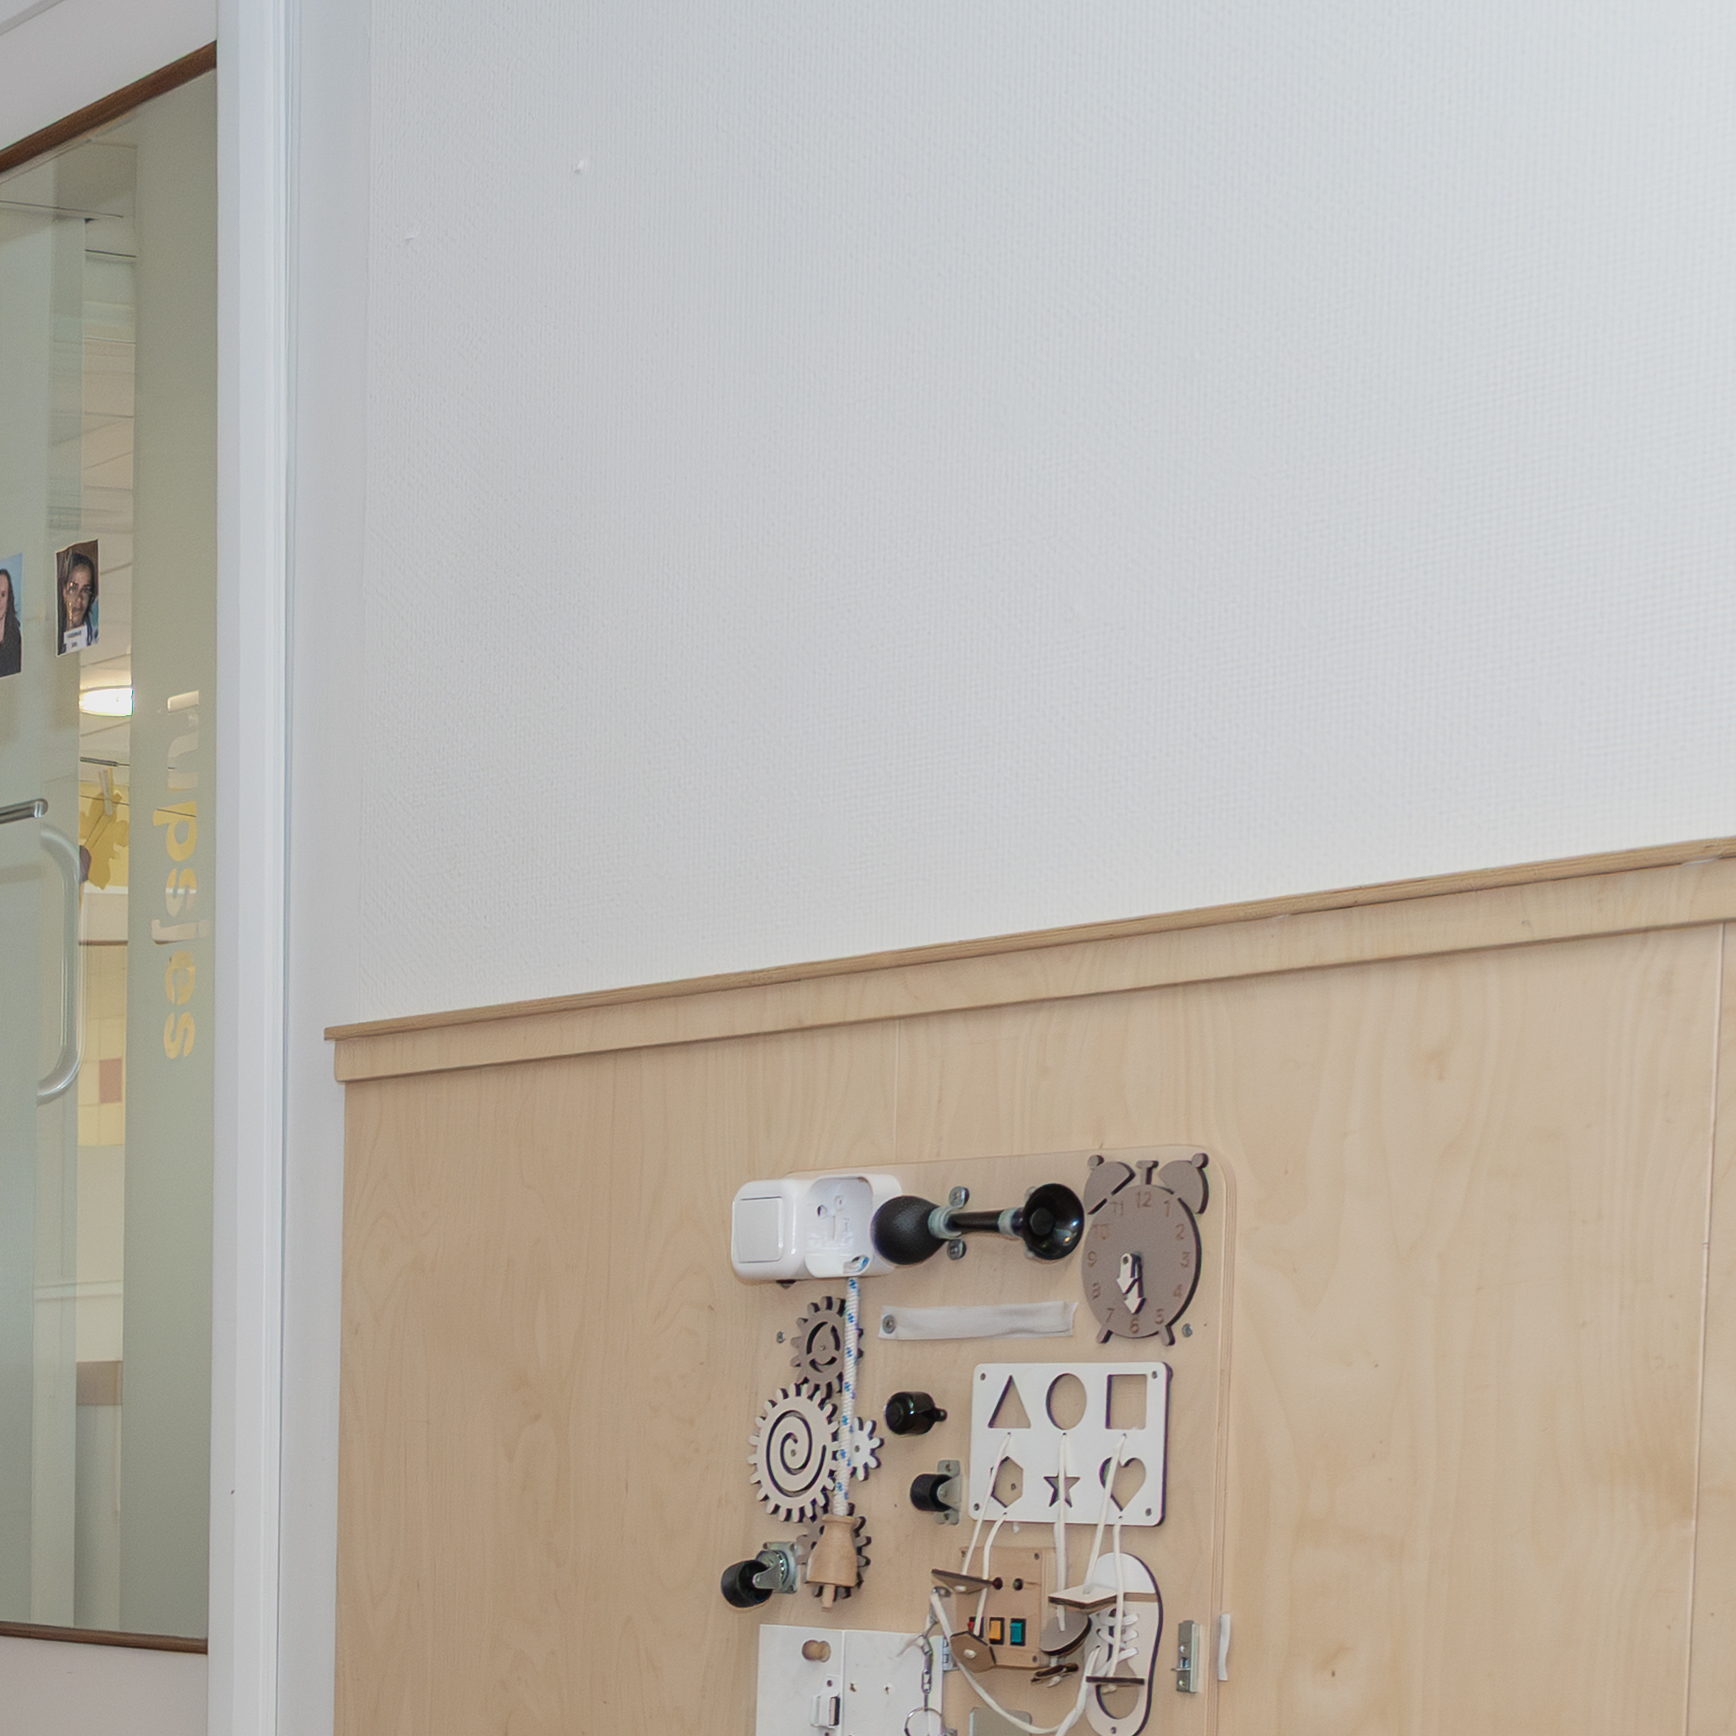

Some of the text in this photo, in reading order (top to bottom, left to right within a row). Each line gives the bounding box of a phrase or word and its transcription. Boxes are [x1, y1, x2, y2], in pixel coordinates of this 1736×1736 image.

[150, 690, 209, 1060] rupsjes
[1134, 1191, 1152, 1209] 12
[1175, 1223, 1185, 1241] 2
[1180, 1251, 1191, 1268] 3
